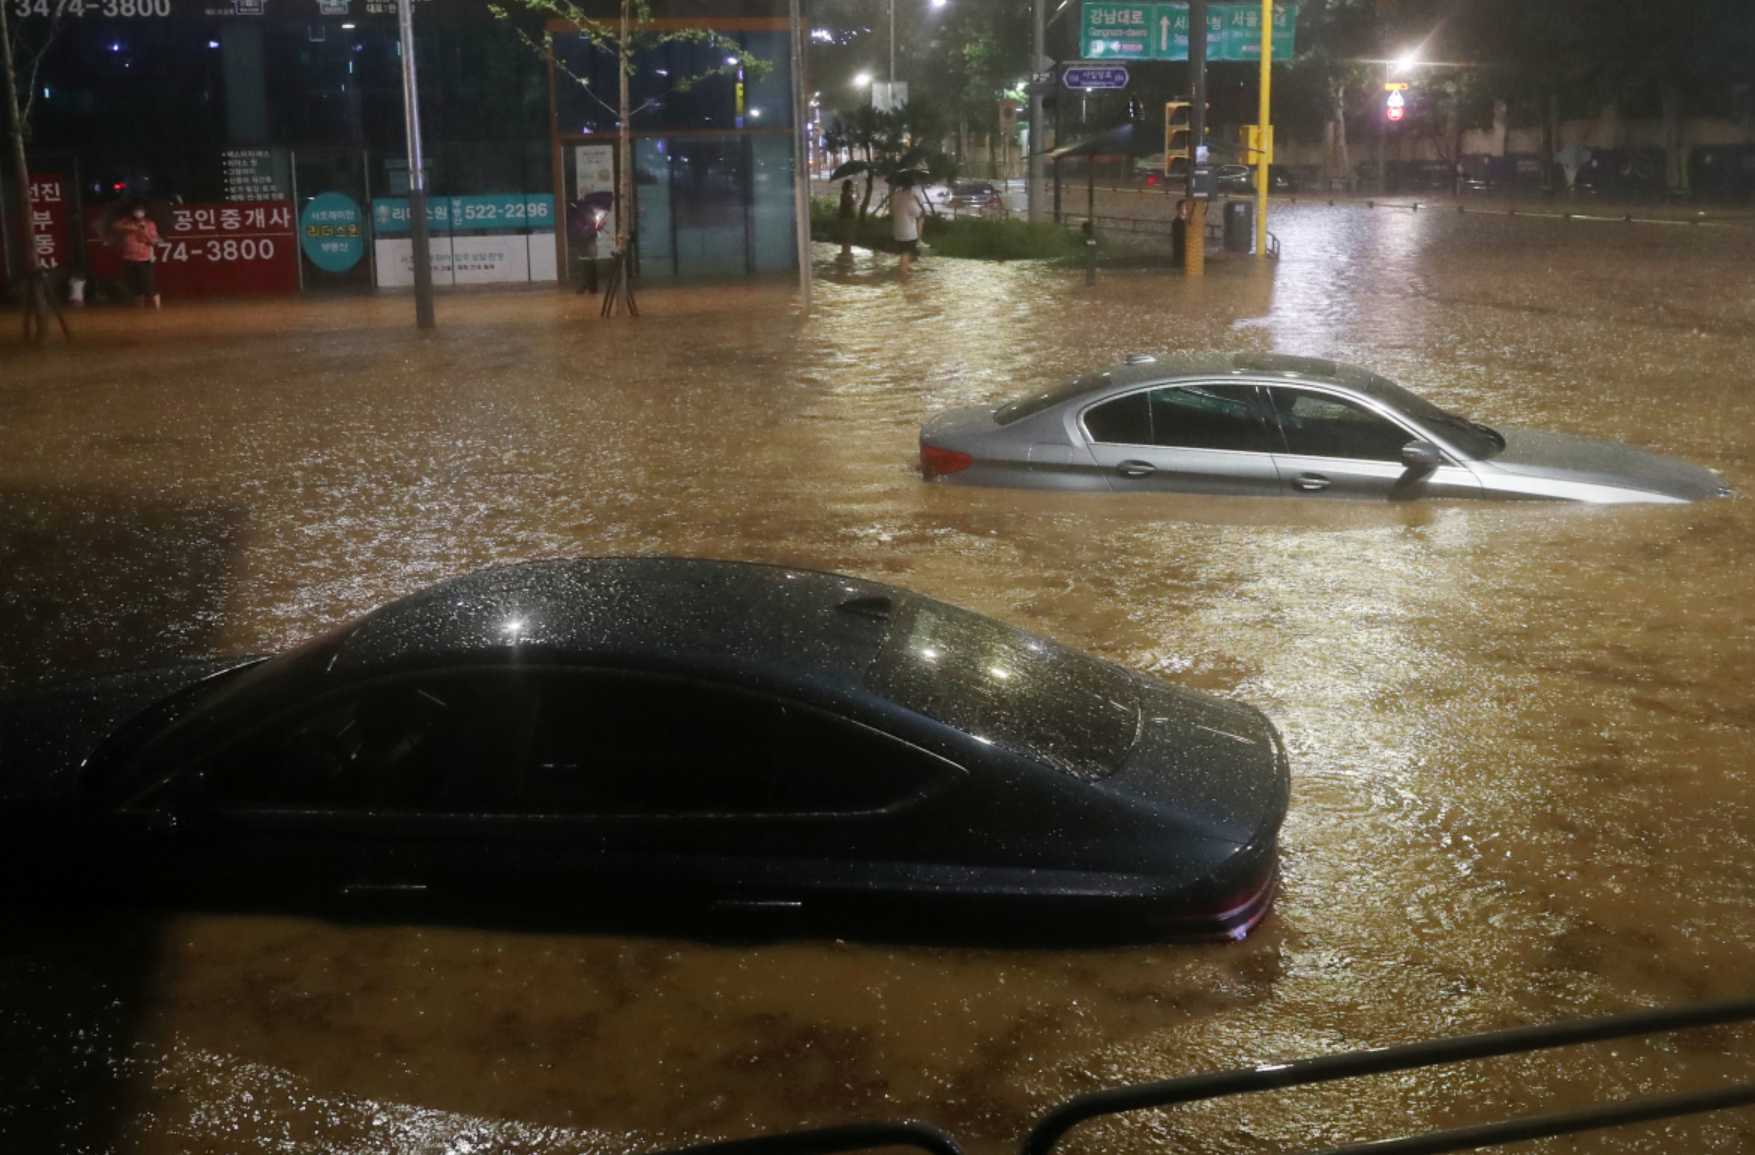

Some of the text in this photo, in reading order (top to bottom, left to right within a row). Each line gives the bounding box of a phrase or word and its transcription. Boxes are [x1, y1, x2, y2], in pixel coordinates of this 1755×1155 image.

[15, 0, 171, 16] 3474-3800
[1089, 8, 1144, 24] 강남대로
[1232, 11, 1286, 27] 서울대
[172, 207, 291, 231] 공인중개사
[392, 205, 448, 220] 리스원
[465, 202, 548, 220] 522-2296
